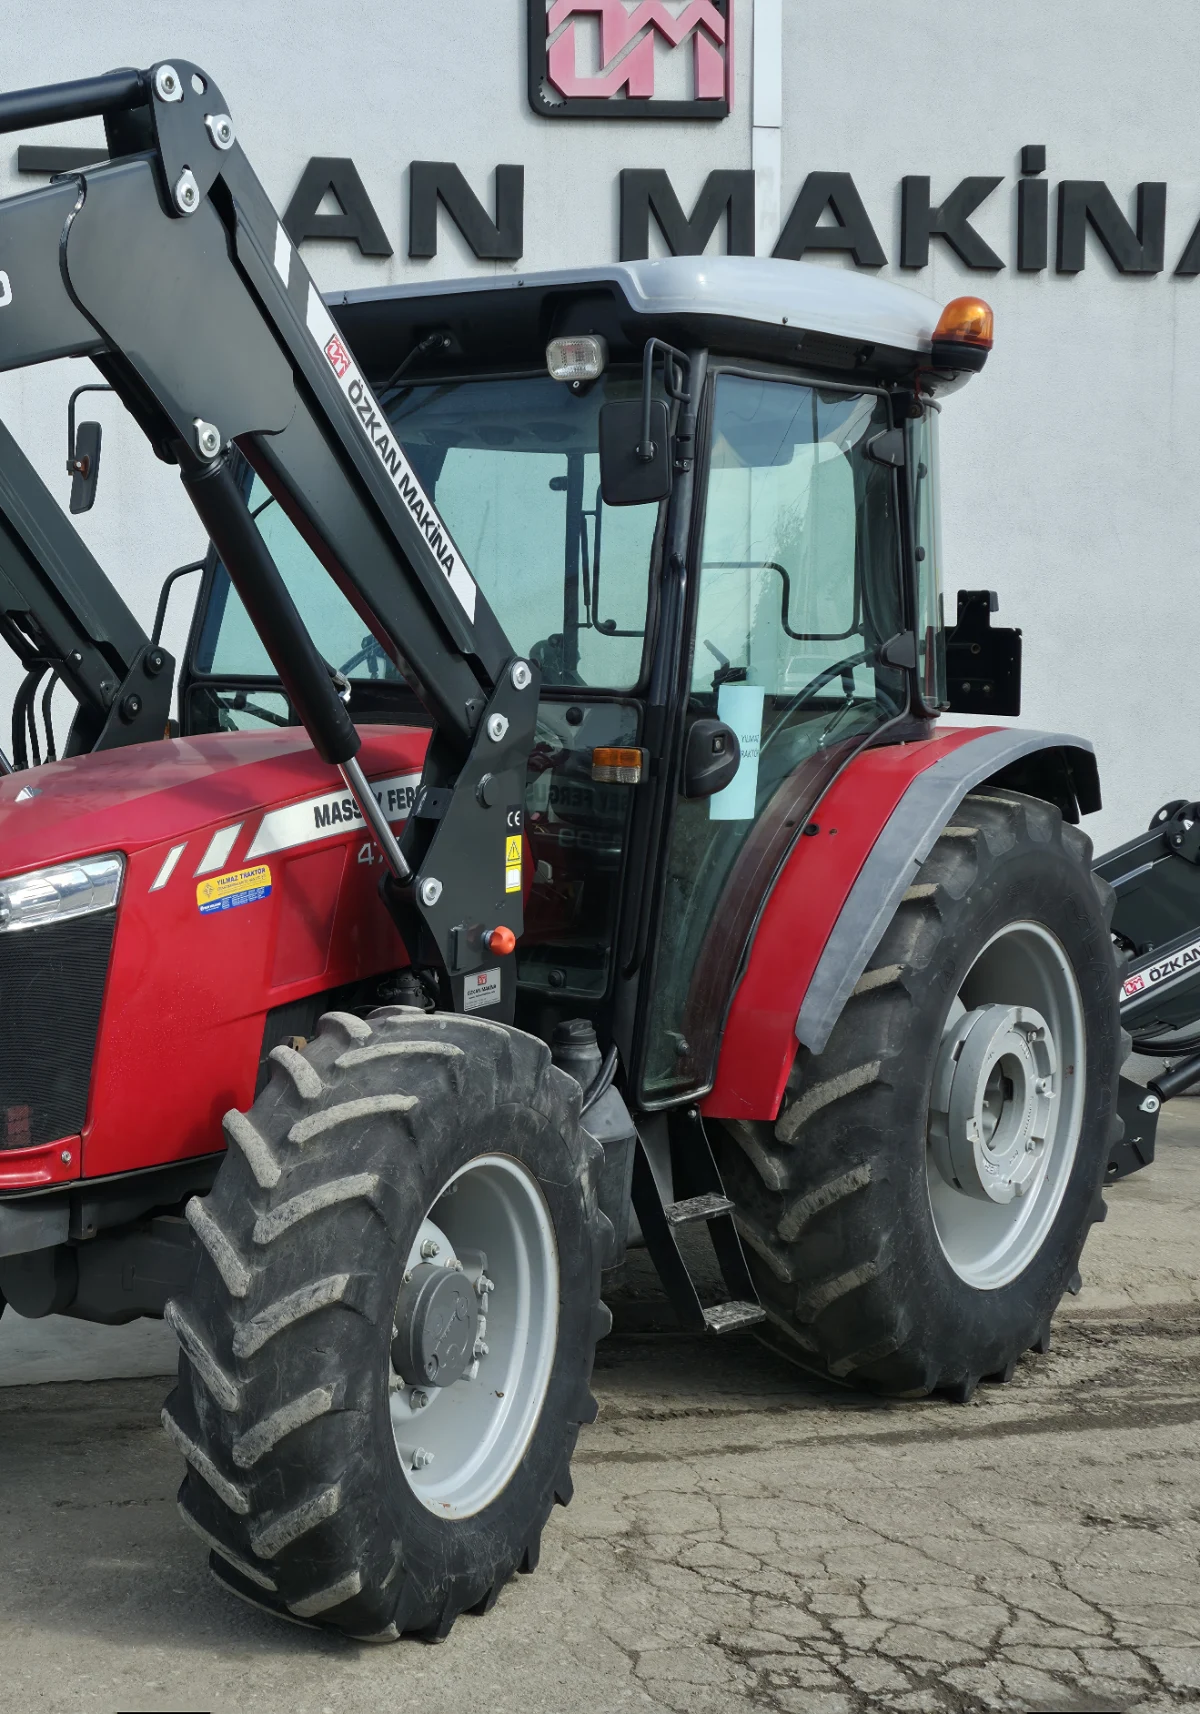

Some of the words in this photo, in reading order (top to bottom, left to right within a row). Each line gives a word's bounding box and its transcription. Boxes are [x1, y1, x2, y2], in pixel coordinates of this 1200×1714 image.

[619, 145, 1200, 275] MAKİN
[347, 379, 401, 479] ÖZKAN
[398, 472, 455, 577] MAKİNA
[216, 875, 238, 885] YILMAZ
